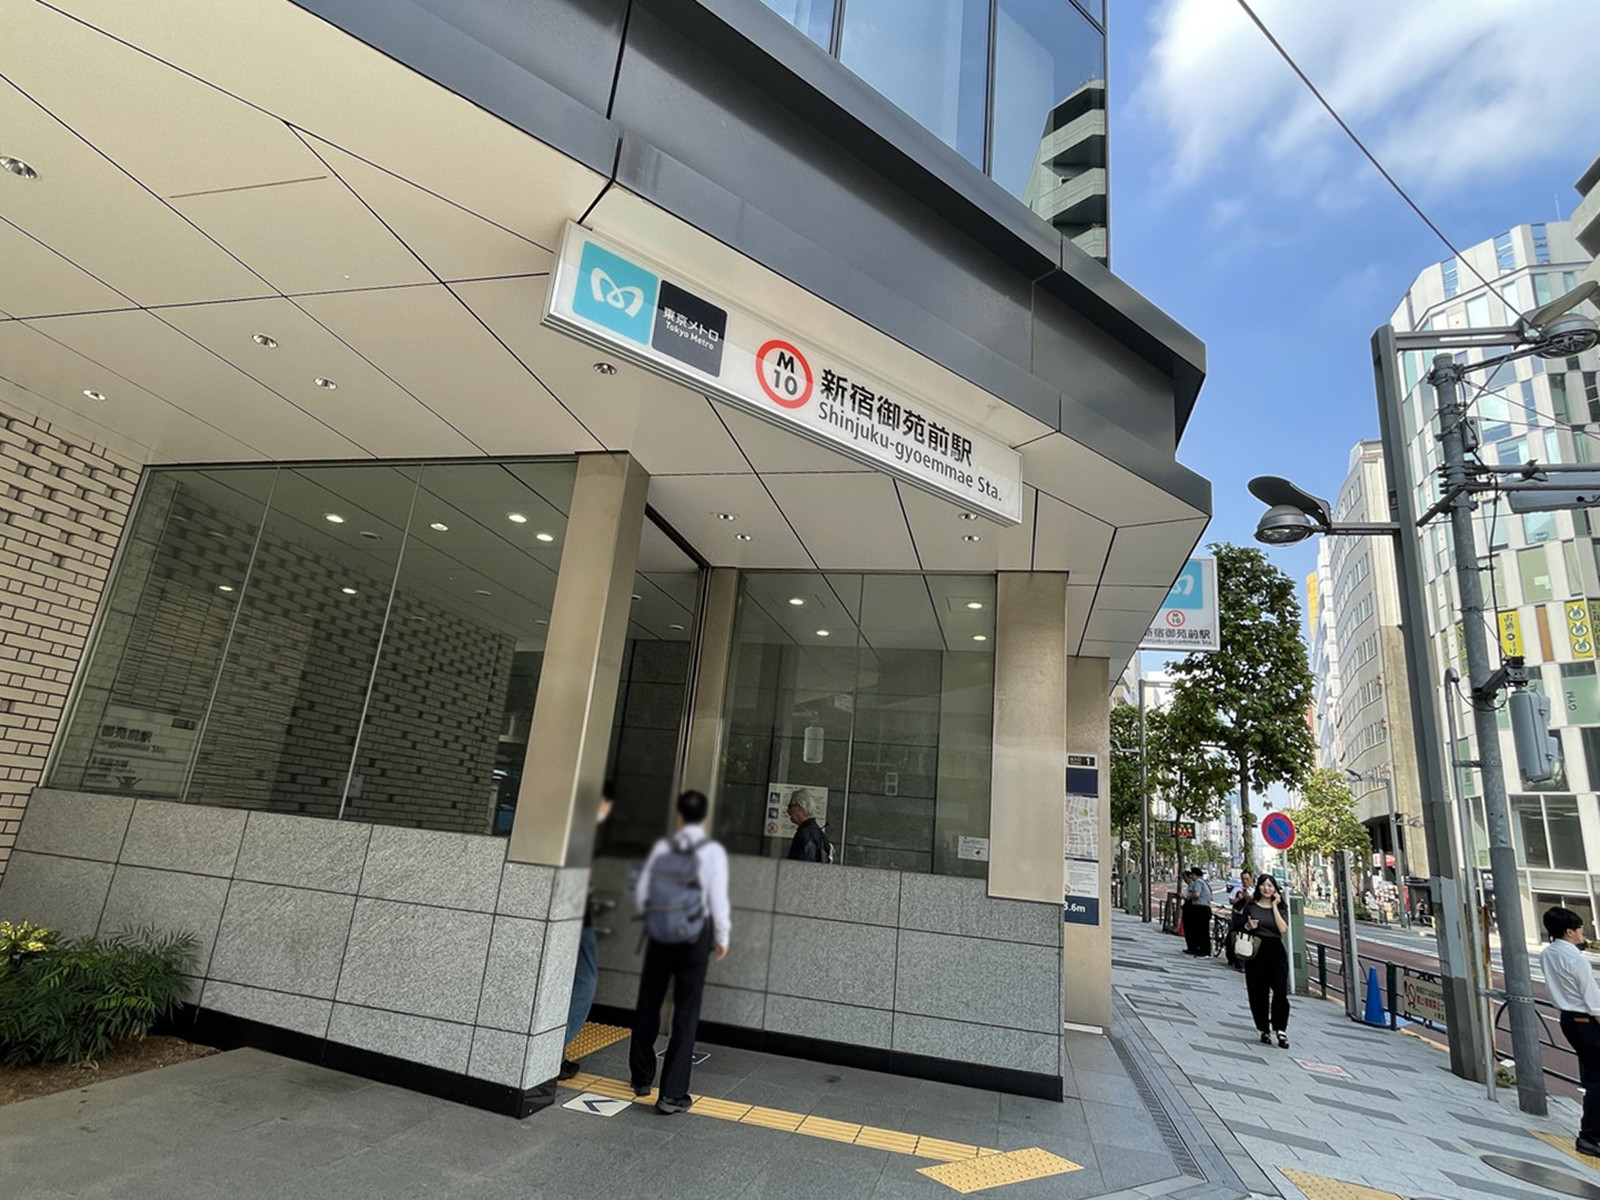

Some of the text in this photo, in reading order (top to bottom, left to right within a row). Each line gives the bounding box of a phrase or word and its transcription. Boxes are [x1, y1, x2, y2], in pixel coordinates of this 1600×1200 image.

[662, 306, 719, 342] 東京メトロ
[665, 320, 715, 350] Tokyo Metro
[776, 351, 795, 374] M
[773, 368, 798, 396] 10
[819, 368, 972, 467] 新宿御苑前駅
[818, 401, 1003, 501] Shinjuku-gyoemmae Sta.
[1567, 690, 1577, 711] GYM
